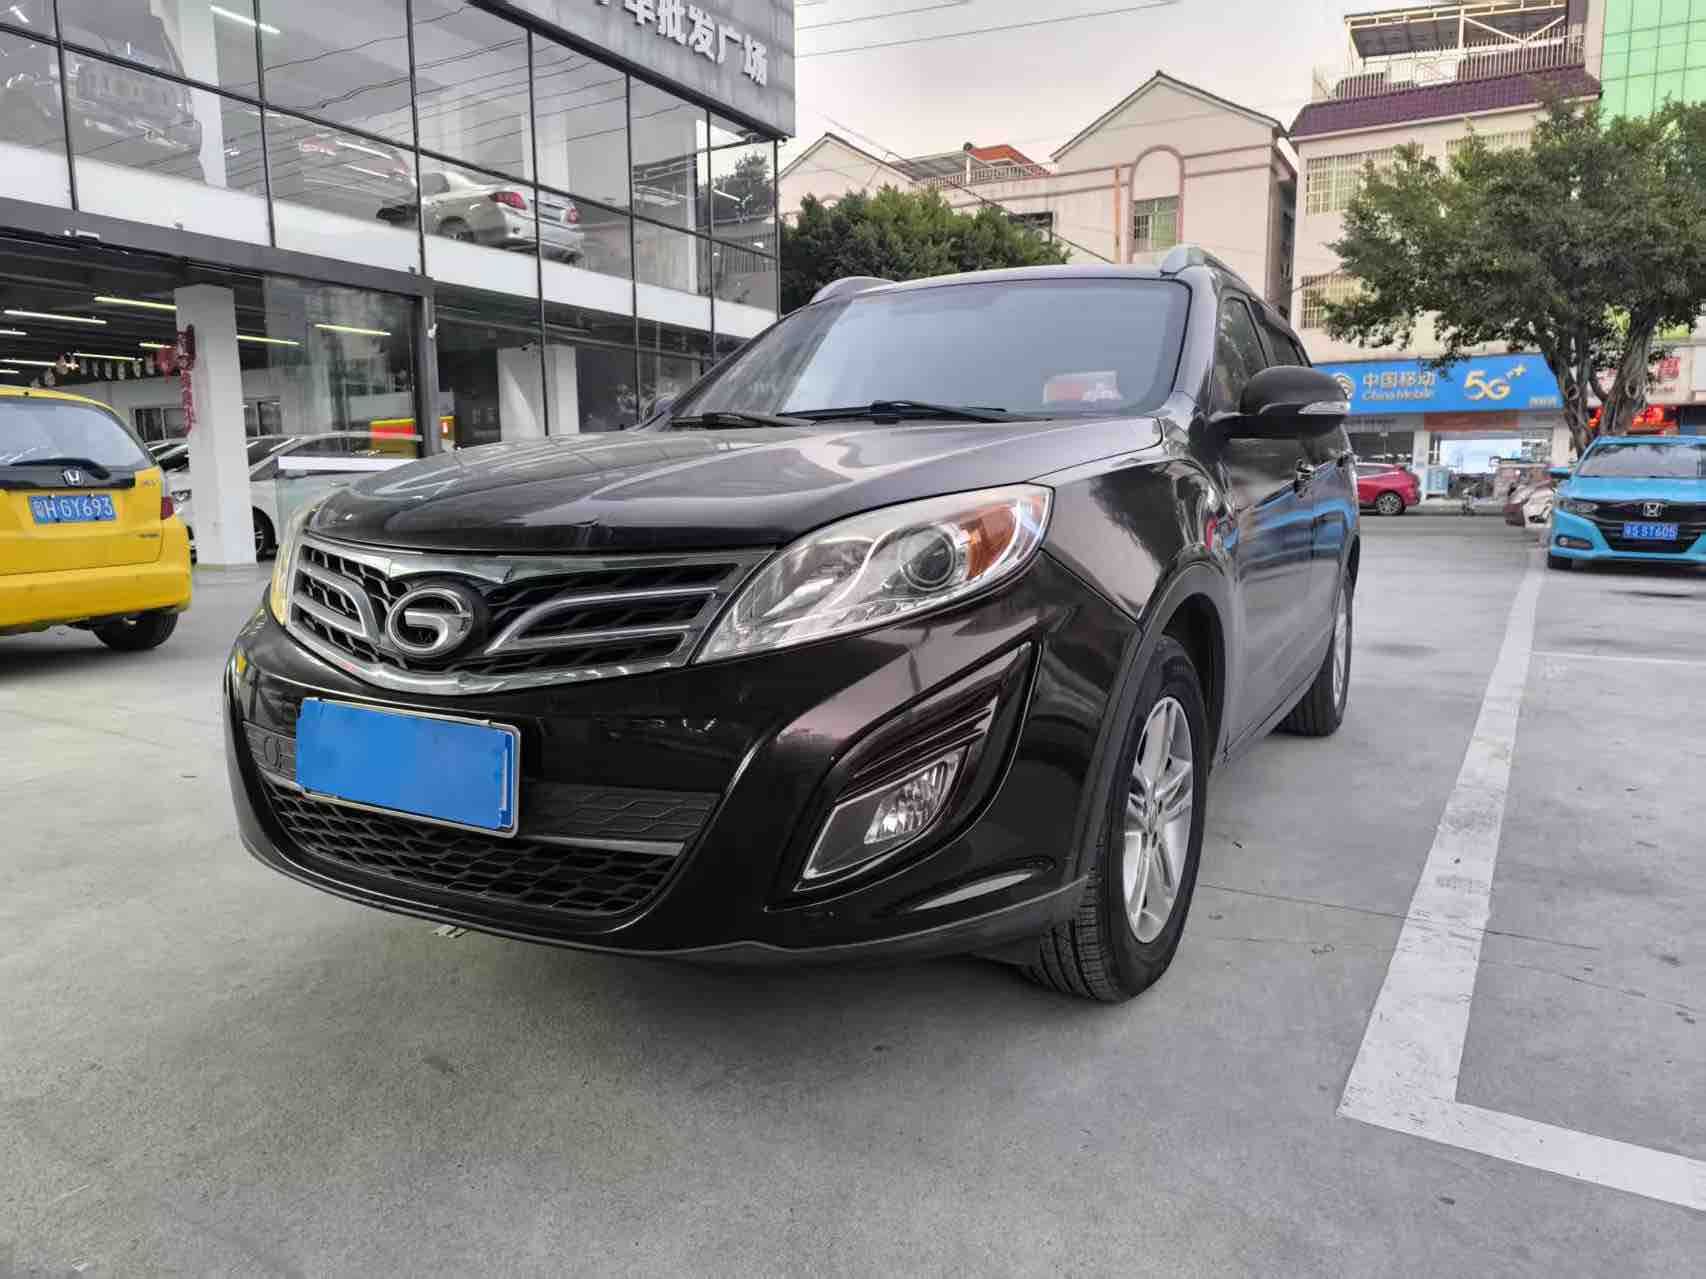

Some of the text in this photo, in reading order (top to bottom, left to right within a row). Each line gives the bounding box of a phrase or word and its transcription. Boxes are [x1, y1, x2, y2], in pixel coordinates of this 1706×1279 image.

[597, 0, 768, 87] 车批发广场
[1362, 370, 1437, 388] 中国移动
